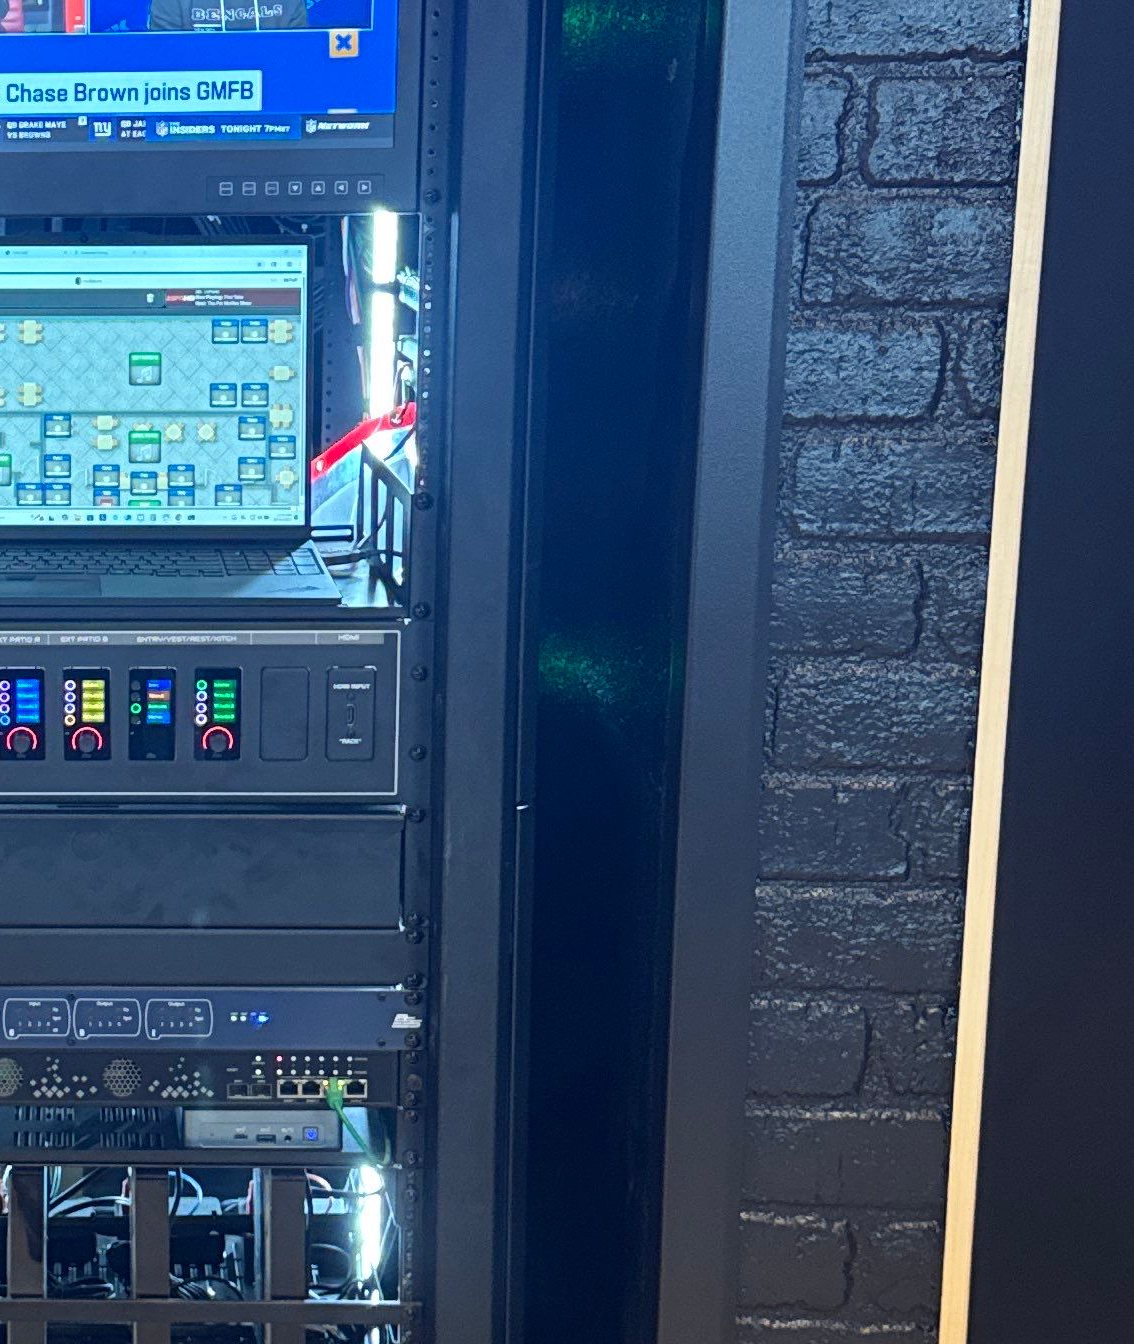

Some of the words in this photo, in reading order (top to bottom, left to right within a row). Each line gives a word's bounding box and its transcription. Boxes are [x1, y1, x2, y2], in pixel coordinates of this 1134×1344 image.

[191, 4, 283, 22] BENGALS
[6, 82, 68, 103] Chase
[74, 82, 140, 102] Brown
[143, 81, 191, 106] joins
[197, 80, 255, 101] GMFB
[168, 125, 215, 135] INSIDERS
[220, 124, 263, 133] TONIGHT
